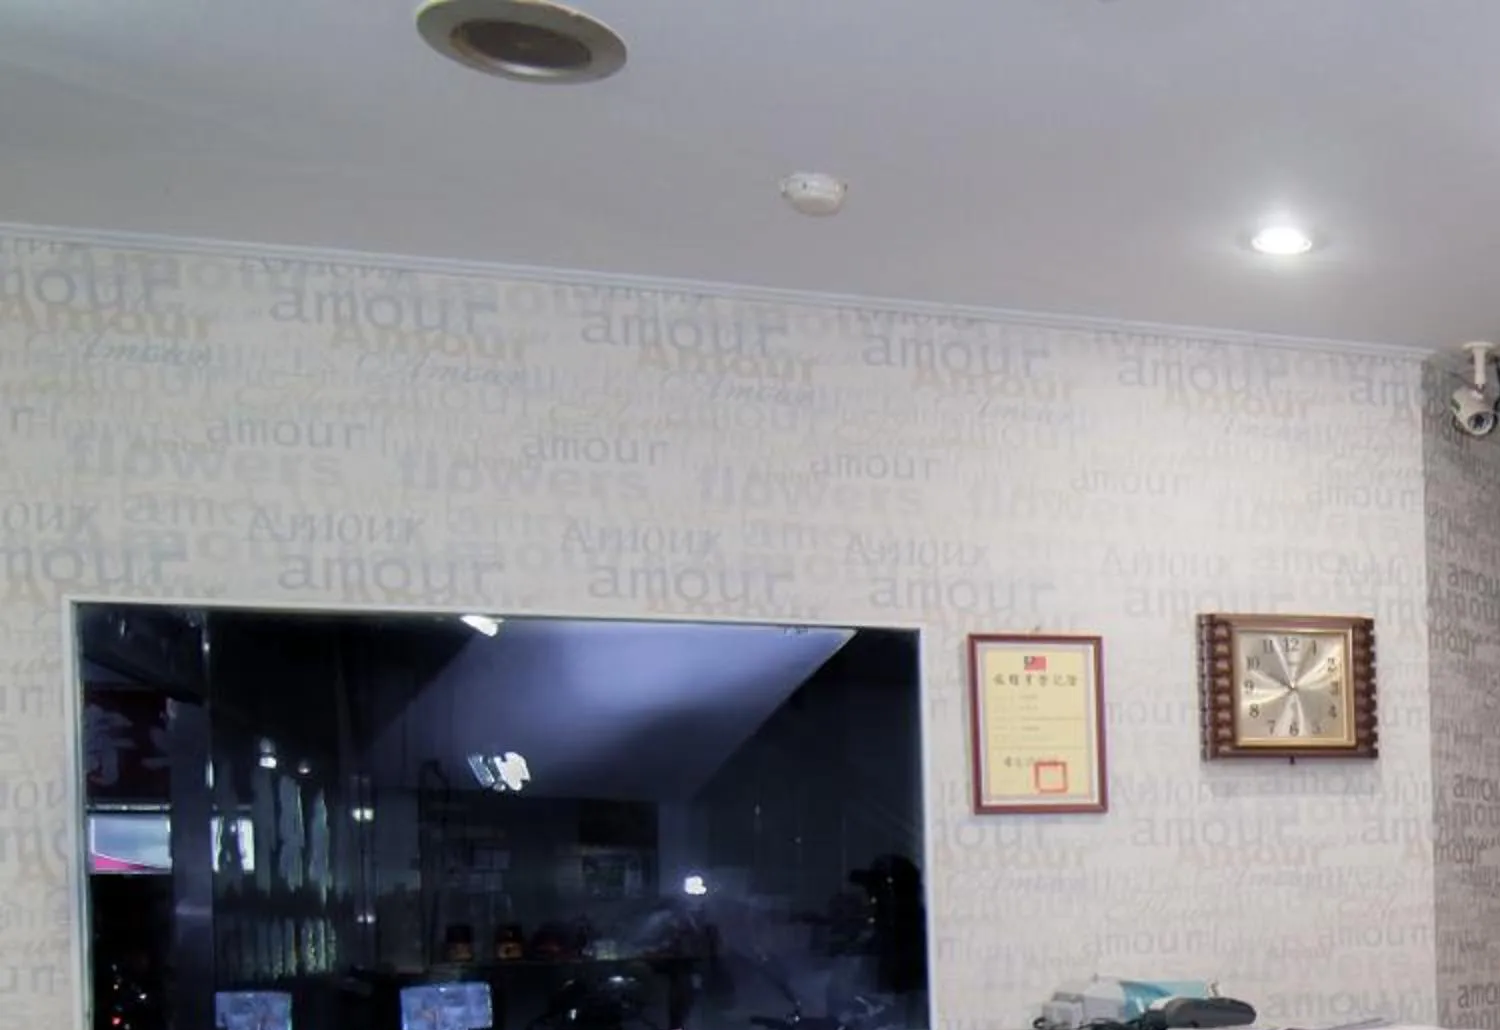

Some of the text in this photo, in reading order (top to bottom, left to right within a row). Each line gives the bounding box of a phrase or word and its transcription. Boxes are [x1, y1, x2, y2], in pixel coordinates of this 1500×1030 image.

[268, 283, 498, 335] amour
[580, 305, 789, 357] amour
[861, 332, 1050, 379] amour
[1117, 352, 1290, 397] amour
[205, 416, 366, 449] amour
[521, 432, 670, 466] amour
[810, 449, 941, 482] amour
[276, 552, 503, 598] amour
[588, 560, 794, 603] amour
[868, 575, 1057, 614] amour
[1130, 815, 1300, 848] amour
